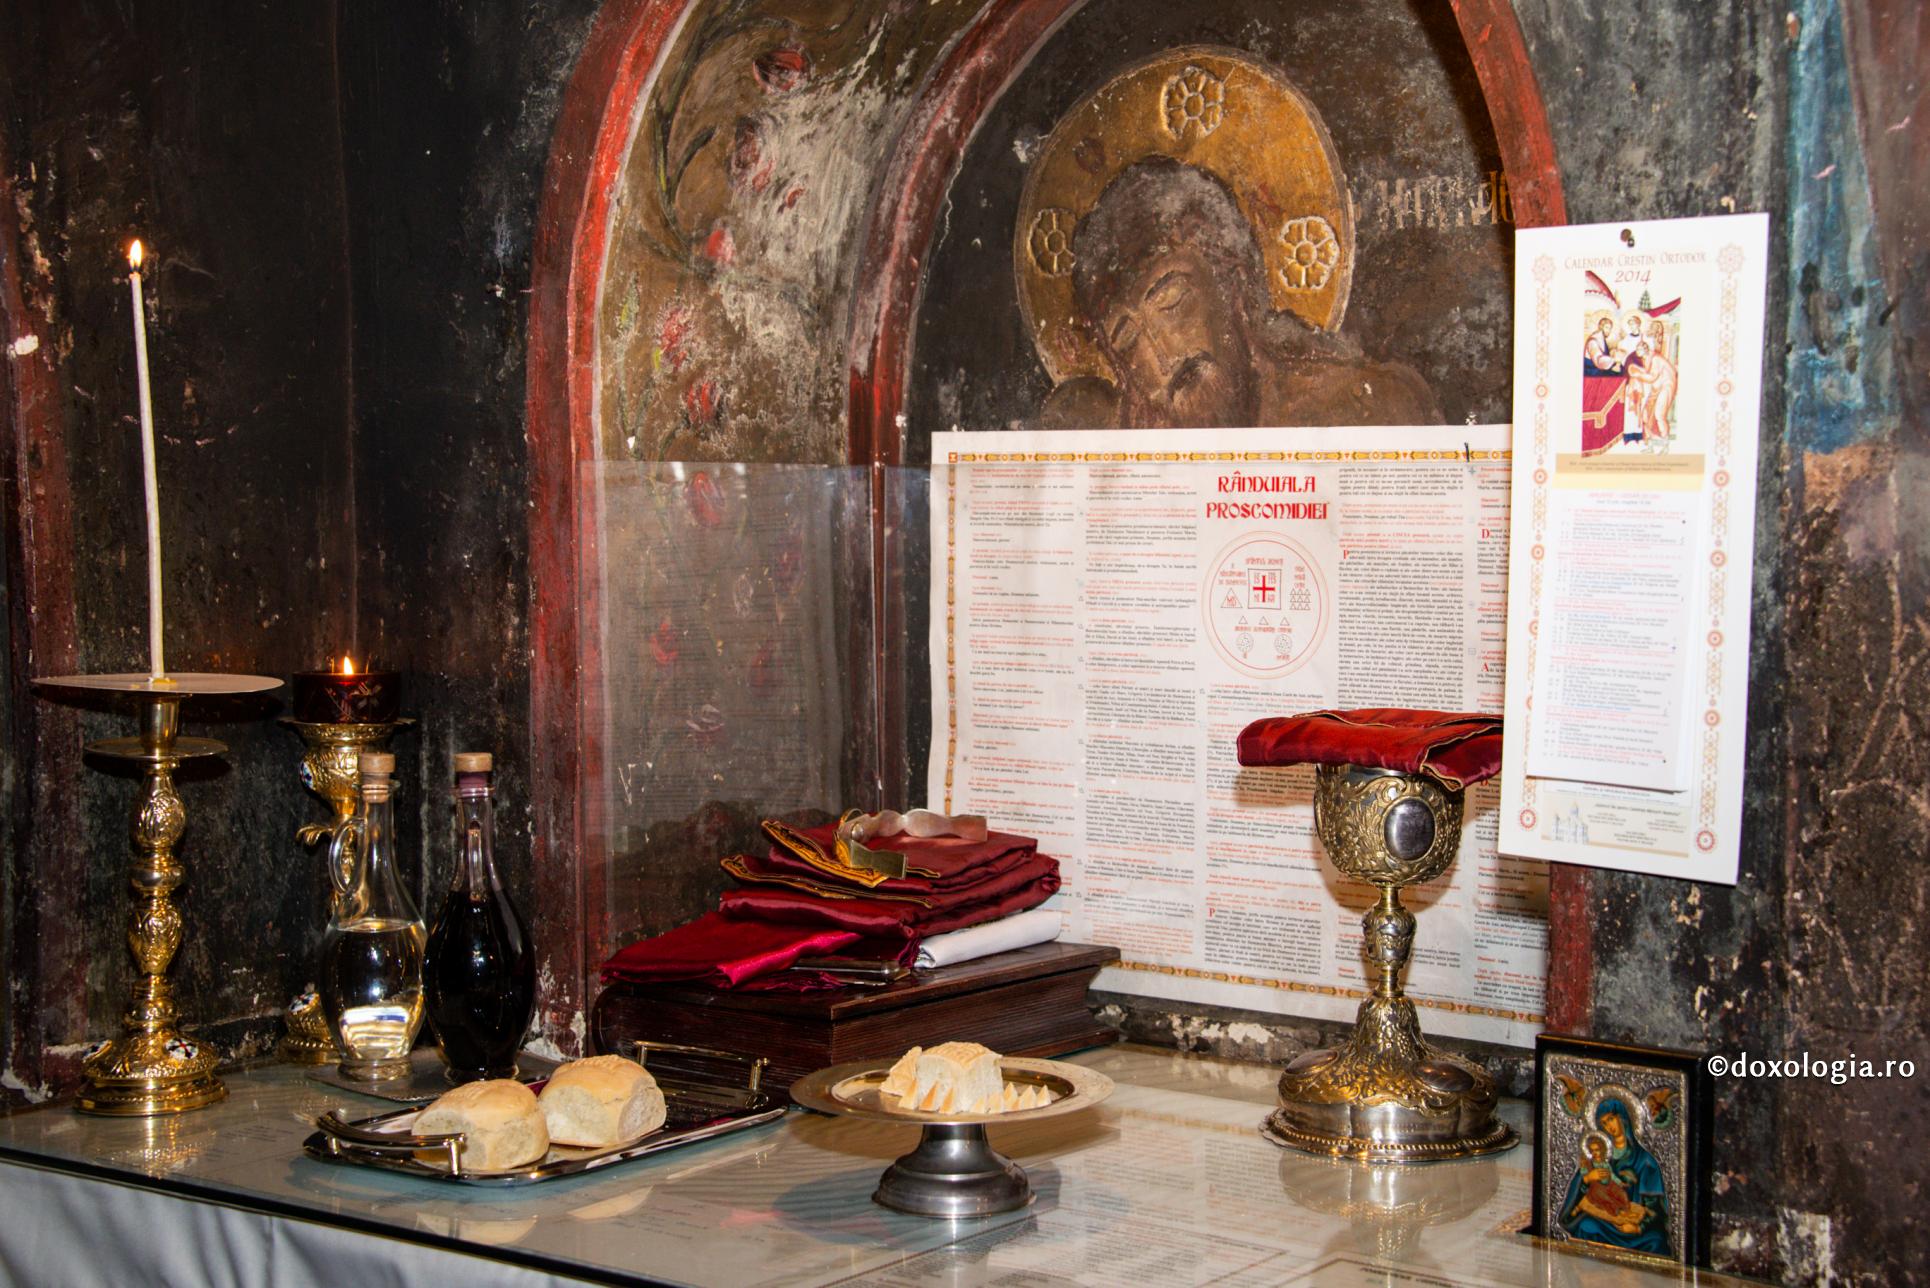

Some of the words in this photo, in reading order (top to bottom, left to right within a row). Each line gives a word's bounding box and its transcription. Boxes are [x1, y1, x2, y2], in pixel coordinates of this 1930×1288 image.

[1614, 270, 1652, 285] 2014
[1217, 469, 1316, 493] RÂNDUIALA
[1206, 501, 1330, 520] PROSCOMIDIEI
